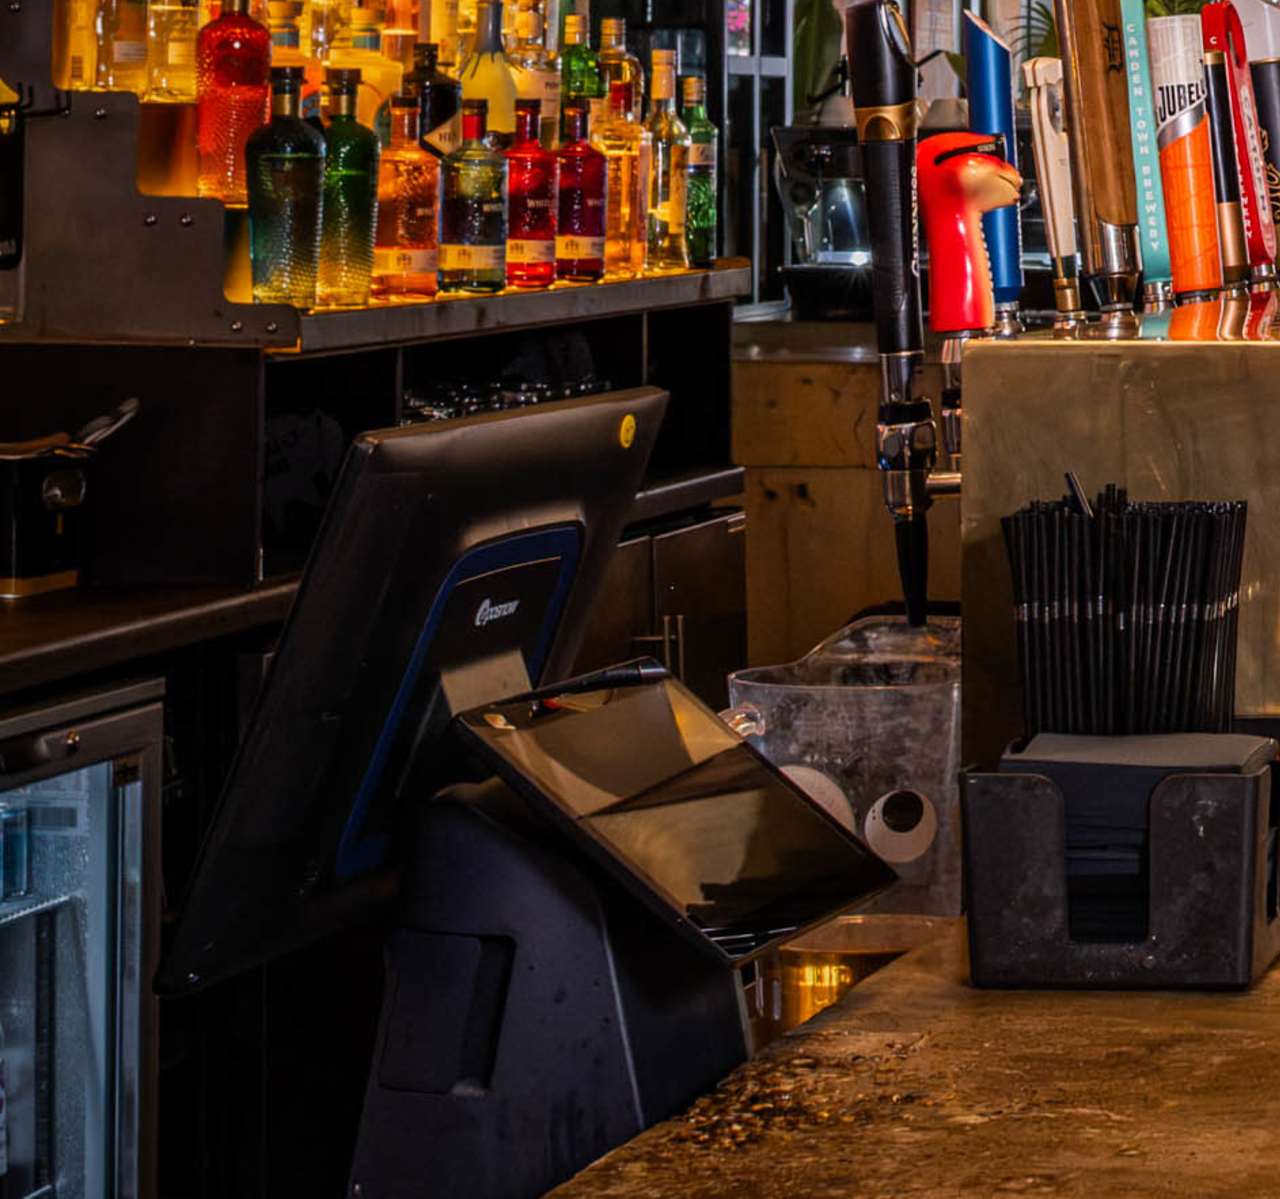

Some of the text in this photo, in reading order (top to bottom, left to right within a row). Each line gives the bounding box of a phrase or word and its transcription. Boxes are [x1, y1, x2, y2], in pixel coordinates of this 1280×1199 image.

[1126, 22, 1161, 254] CAMDEN TOWN BREWERY
